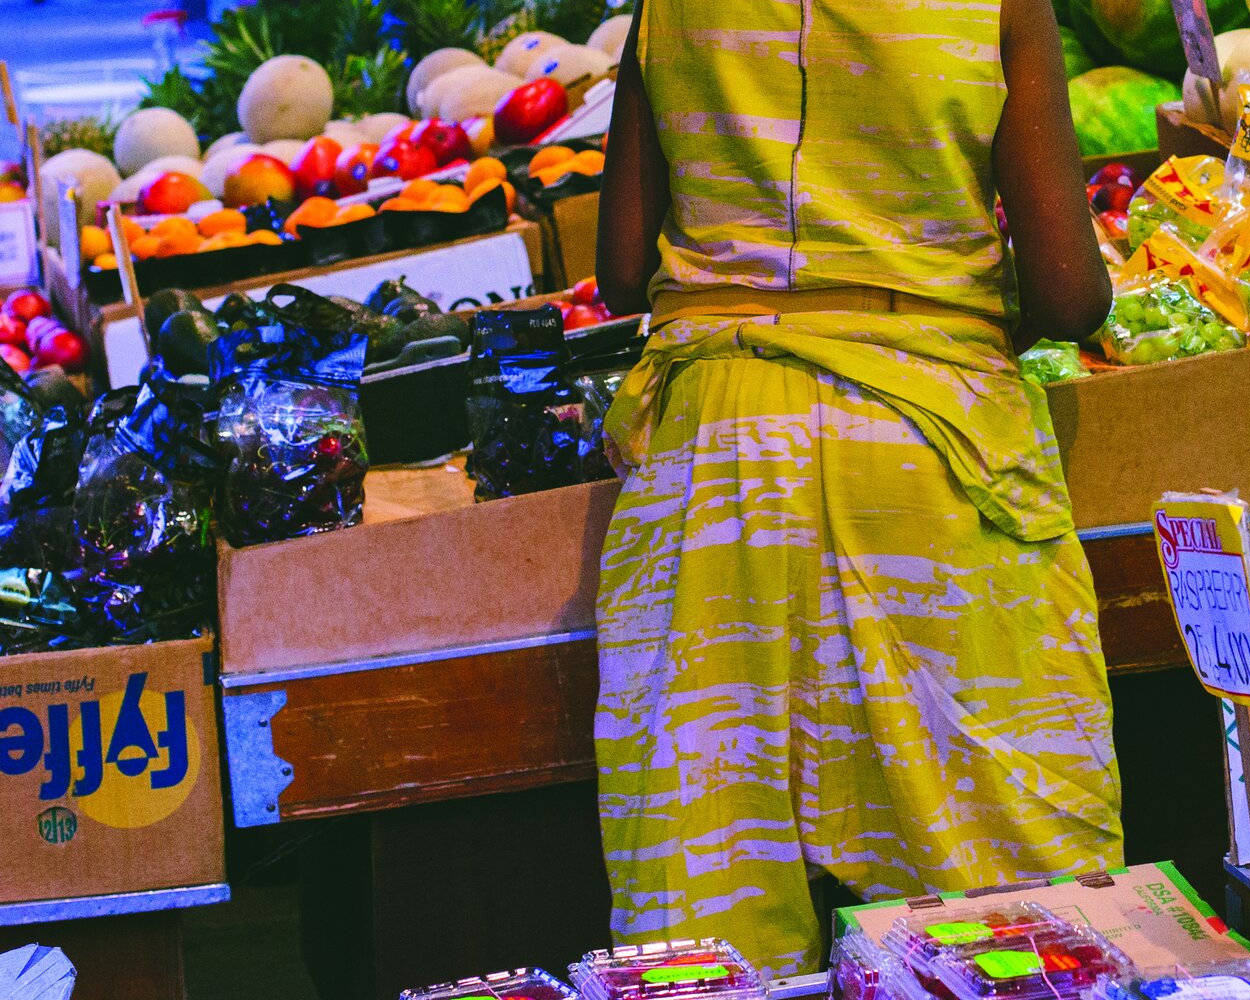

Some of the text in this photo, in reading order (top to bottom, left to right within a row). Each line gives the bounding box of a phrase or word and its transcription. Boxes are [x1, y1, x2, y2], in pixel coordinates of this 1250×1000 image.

[1156, 510, 1222, 568] SPECIAL
[26, 679, 61, 695] times
[63, 675, 96, 693] Fyffe
[1145, 881, 1177, 905] DSA
